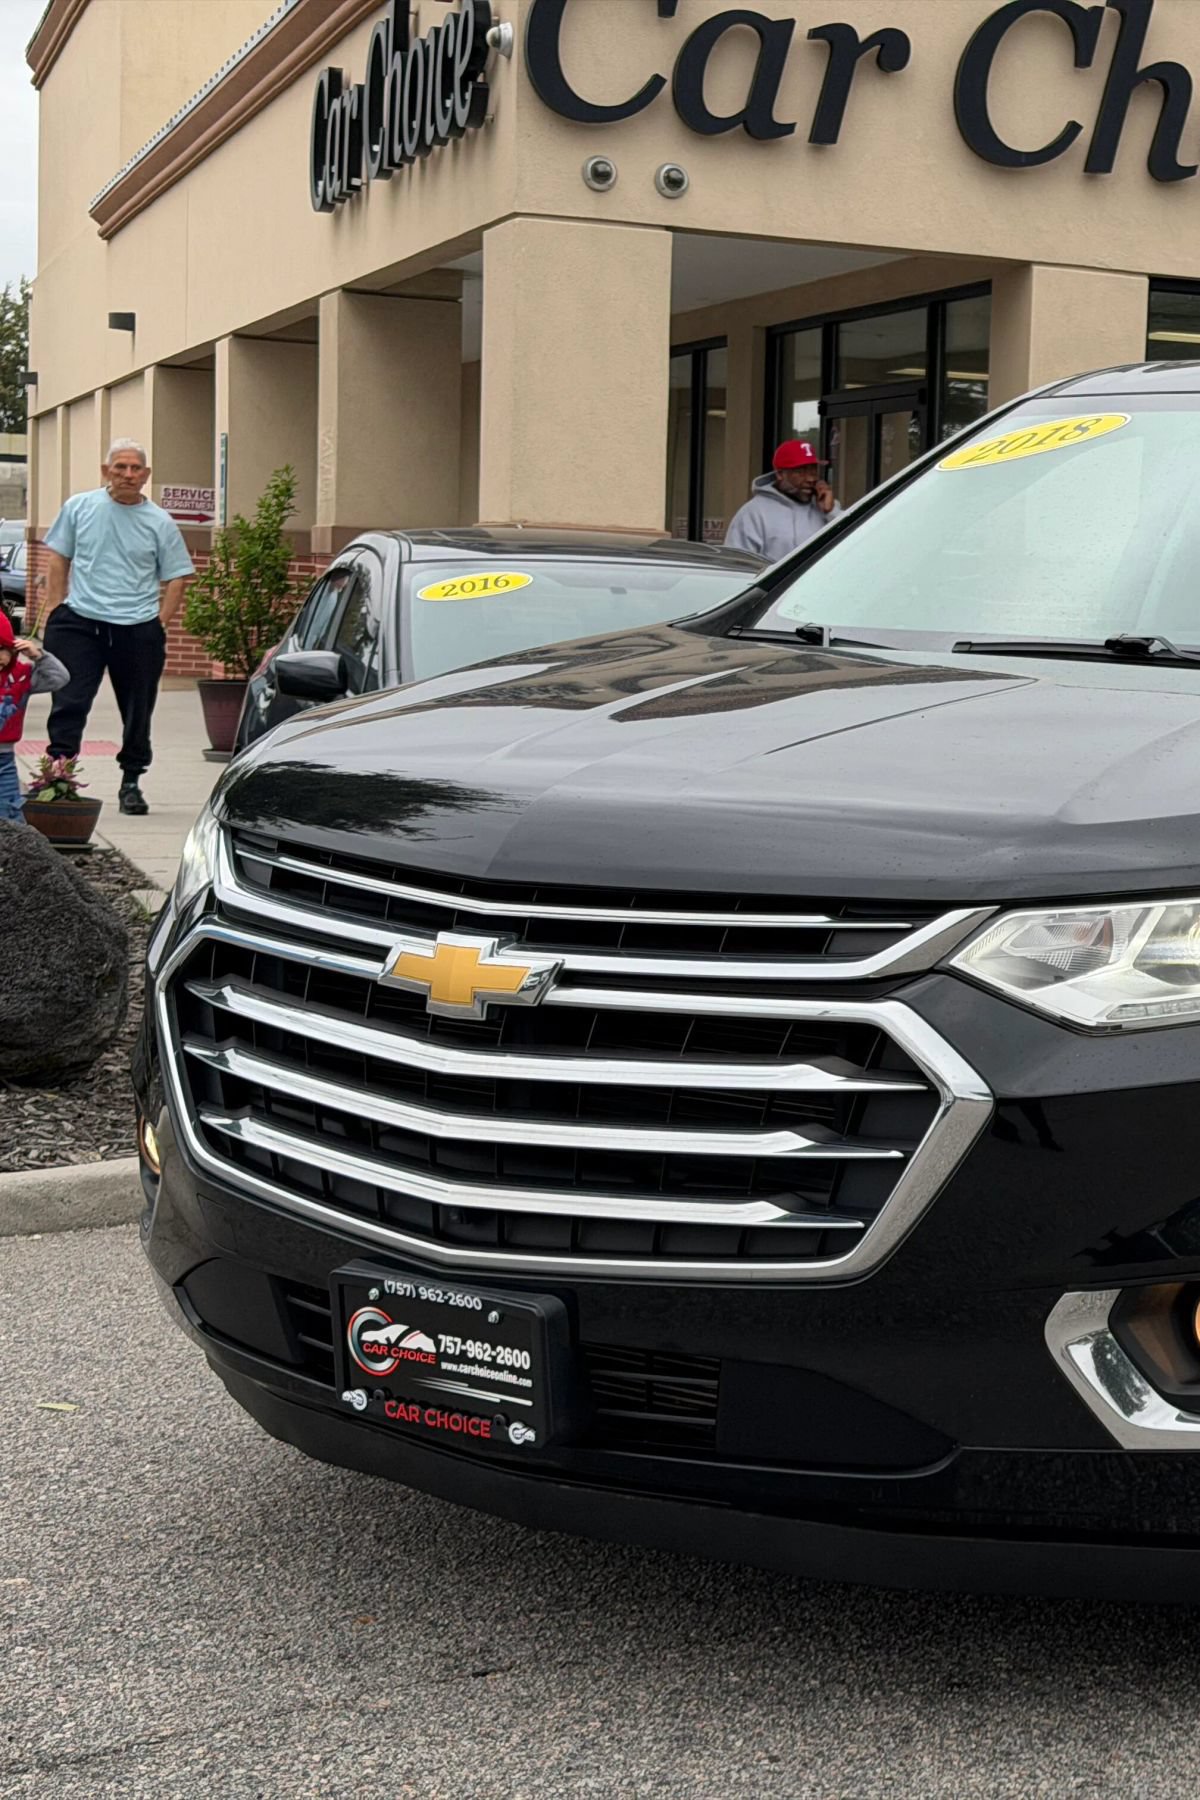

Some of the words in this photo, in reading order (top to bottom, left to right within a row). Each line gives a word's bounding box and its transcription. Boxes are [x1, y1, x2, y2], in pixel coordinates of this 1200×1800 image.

[525, 0, 911, 146] Car
[309, 67, 365, 214] Car
[363, 0, 491, 180] Choice
[959, 417, 1103, 466] 2018
[441, 574, 511, 597] 2016
[384, 1279, 417, 1298] (757)
[418, 1286, 483, 1311] 962-2600
[362, 1342, 388, 1356] CAR
[390, 1347, 437, 1365] CHOICE
[437, 1334, 531, 1370] 757-962-2600
[440, 1361, 532, 1387] www.carchoiceonline.com
[384, 1400, 420, 1424] CAR
[424, 1409, 492, 1439] CHOICE
